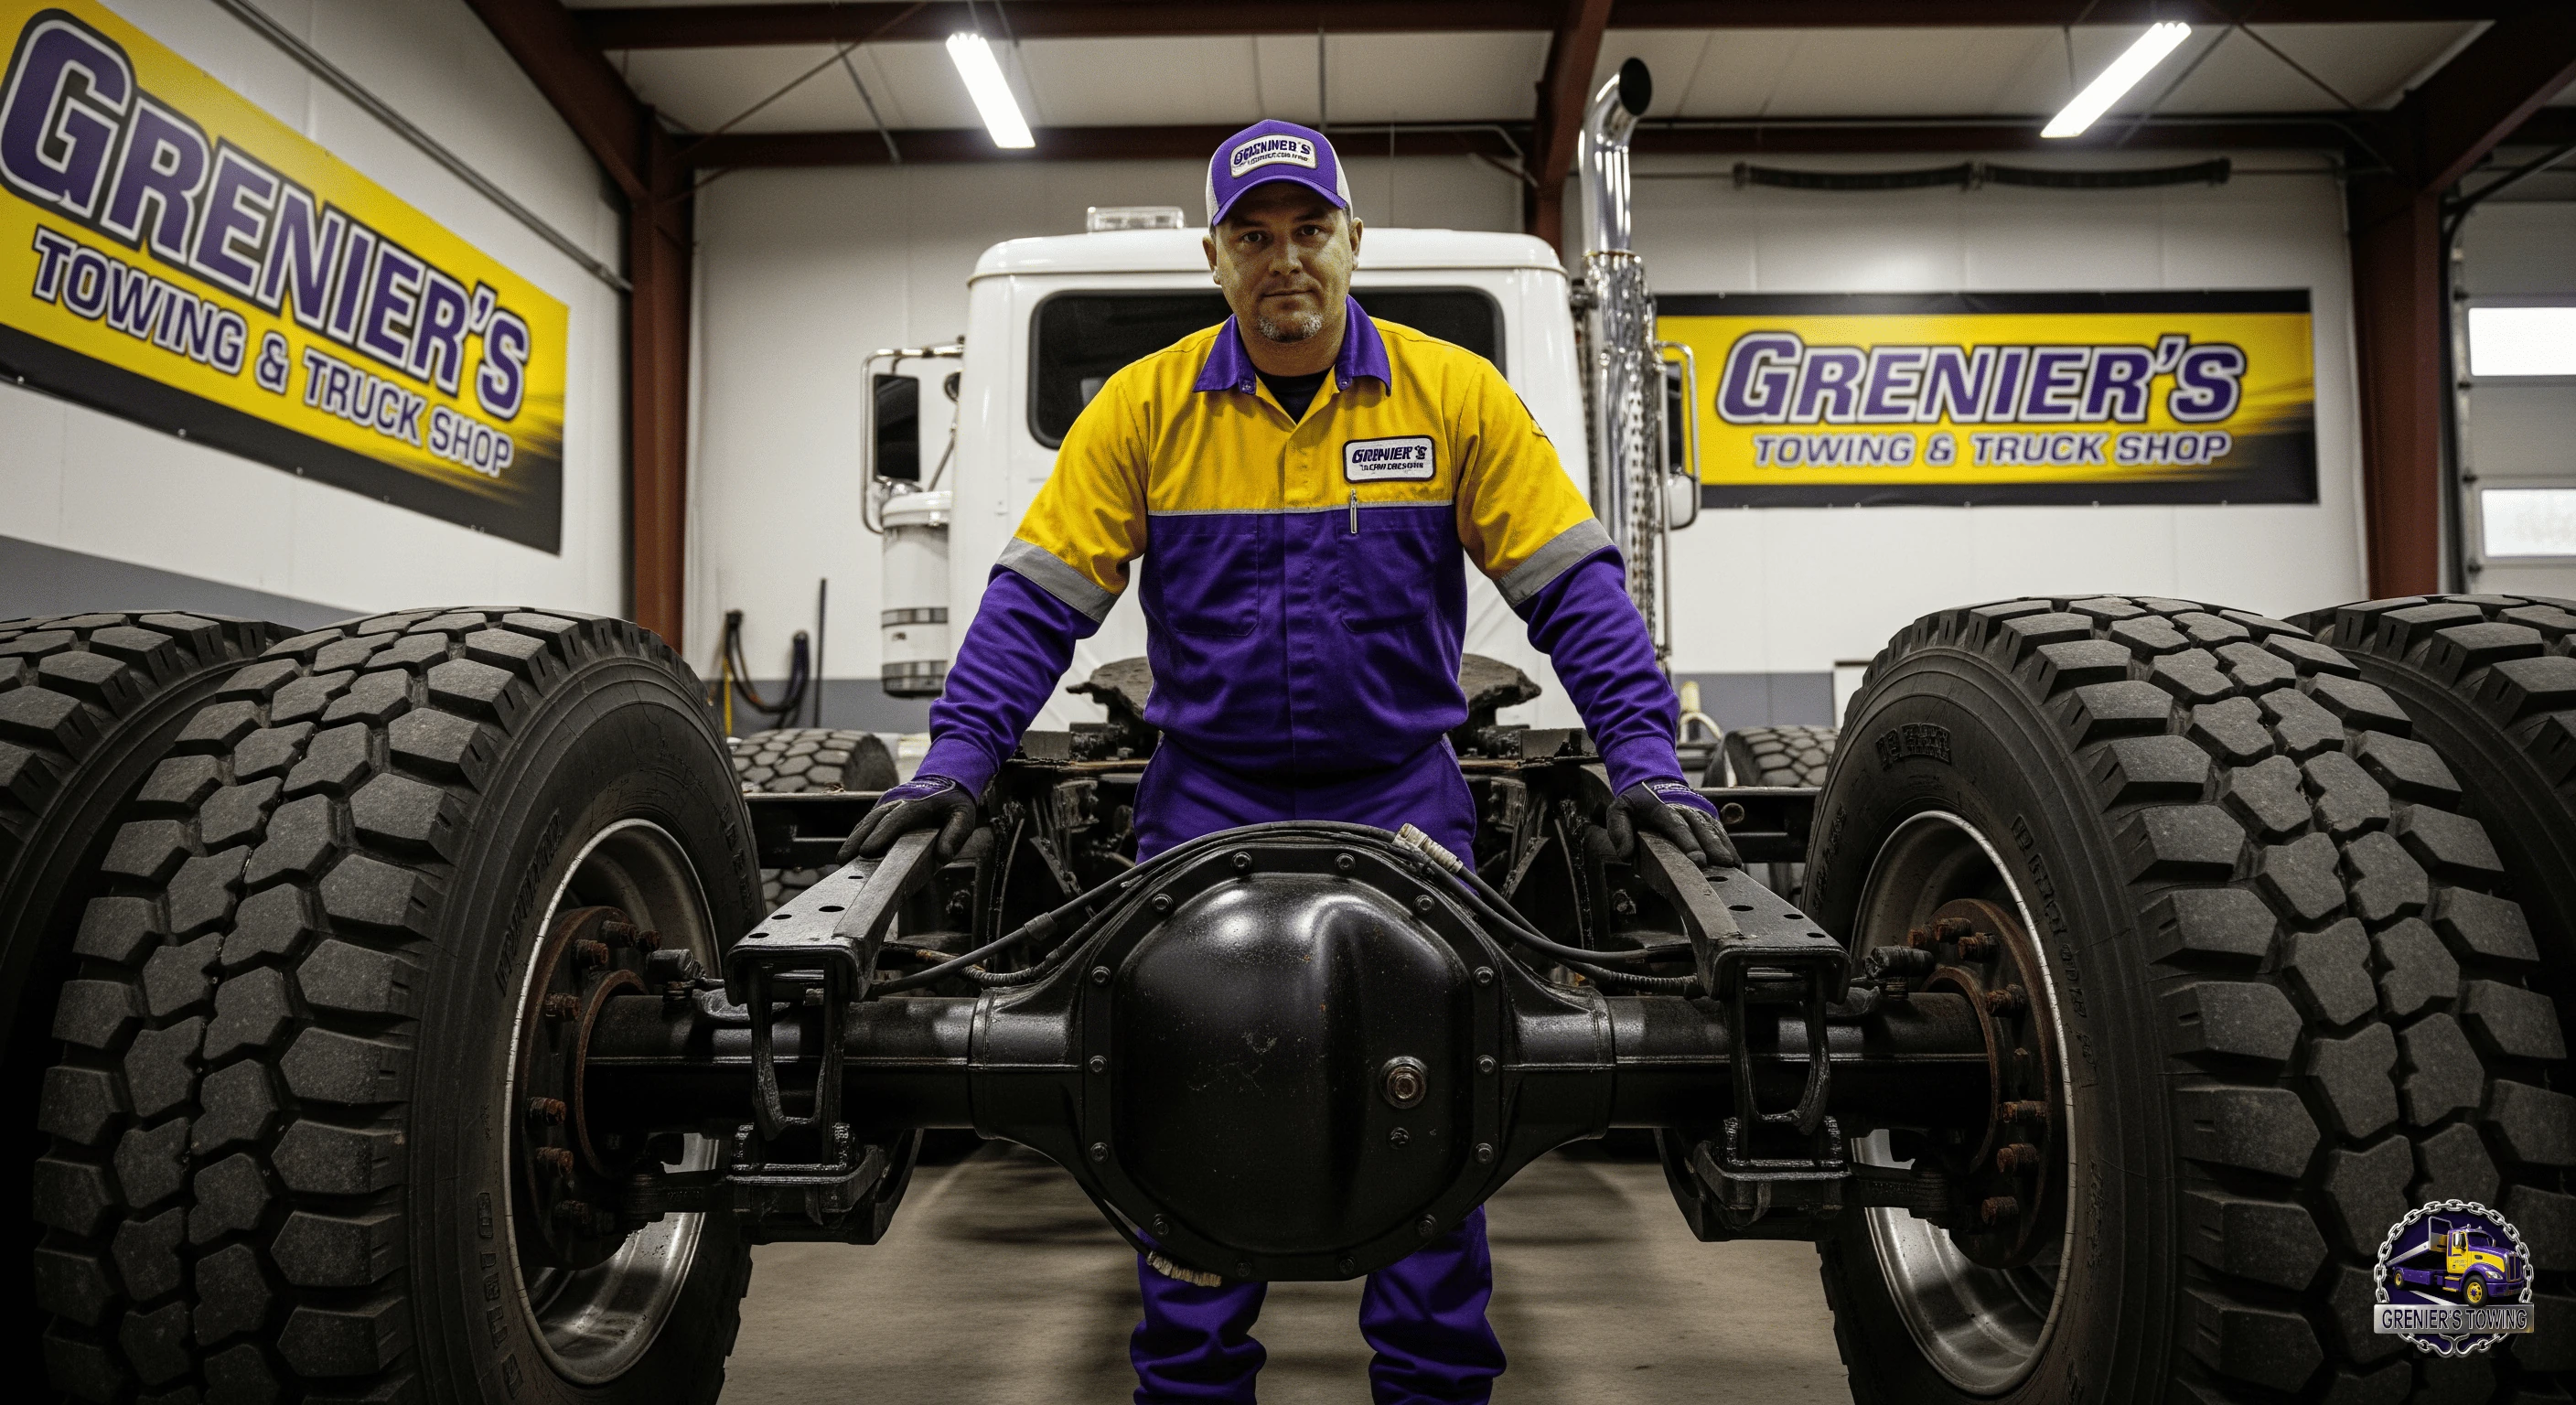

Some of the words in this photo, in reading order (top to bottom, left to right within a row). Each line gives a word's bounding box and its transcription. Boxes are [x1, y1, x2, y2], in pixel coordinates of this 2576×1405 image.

[0, 18, 530, 420] GRENIER'S
[33, 226, 246, 375] TOWING
[255, 332, 290, 393] &
[303, 351, 427, 447] TRUCK
[430, 405, 514, 476] SHOP
[1718, 332, 2241, 424] GRENIER'S
[1754, 431, 1918, 467] TOWING
[1926, 432, 1957, 467] &
[1970, 431, 2109, 467] TRUCK
[2114, 430, 2233, 467] SHOP
